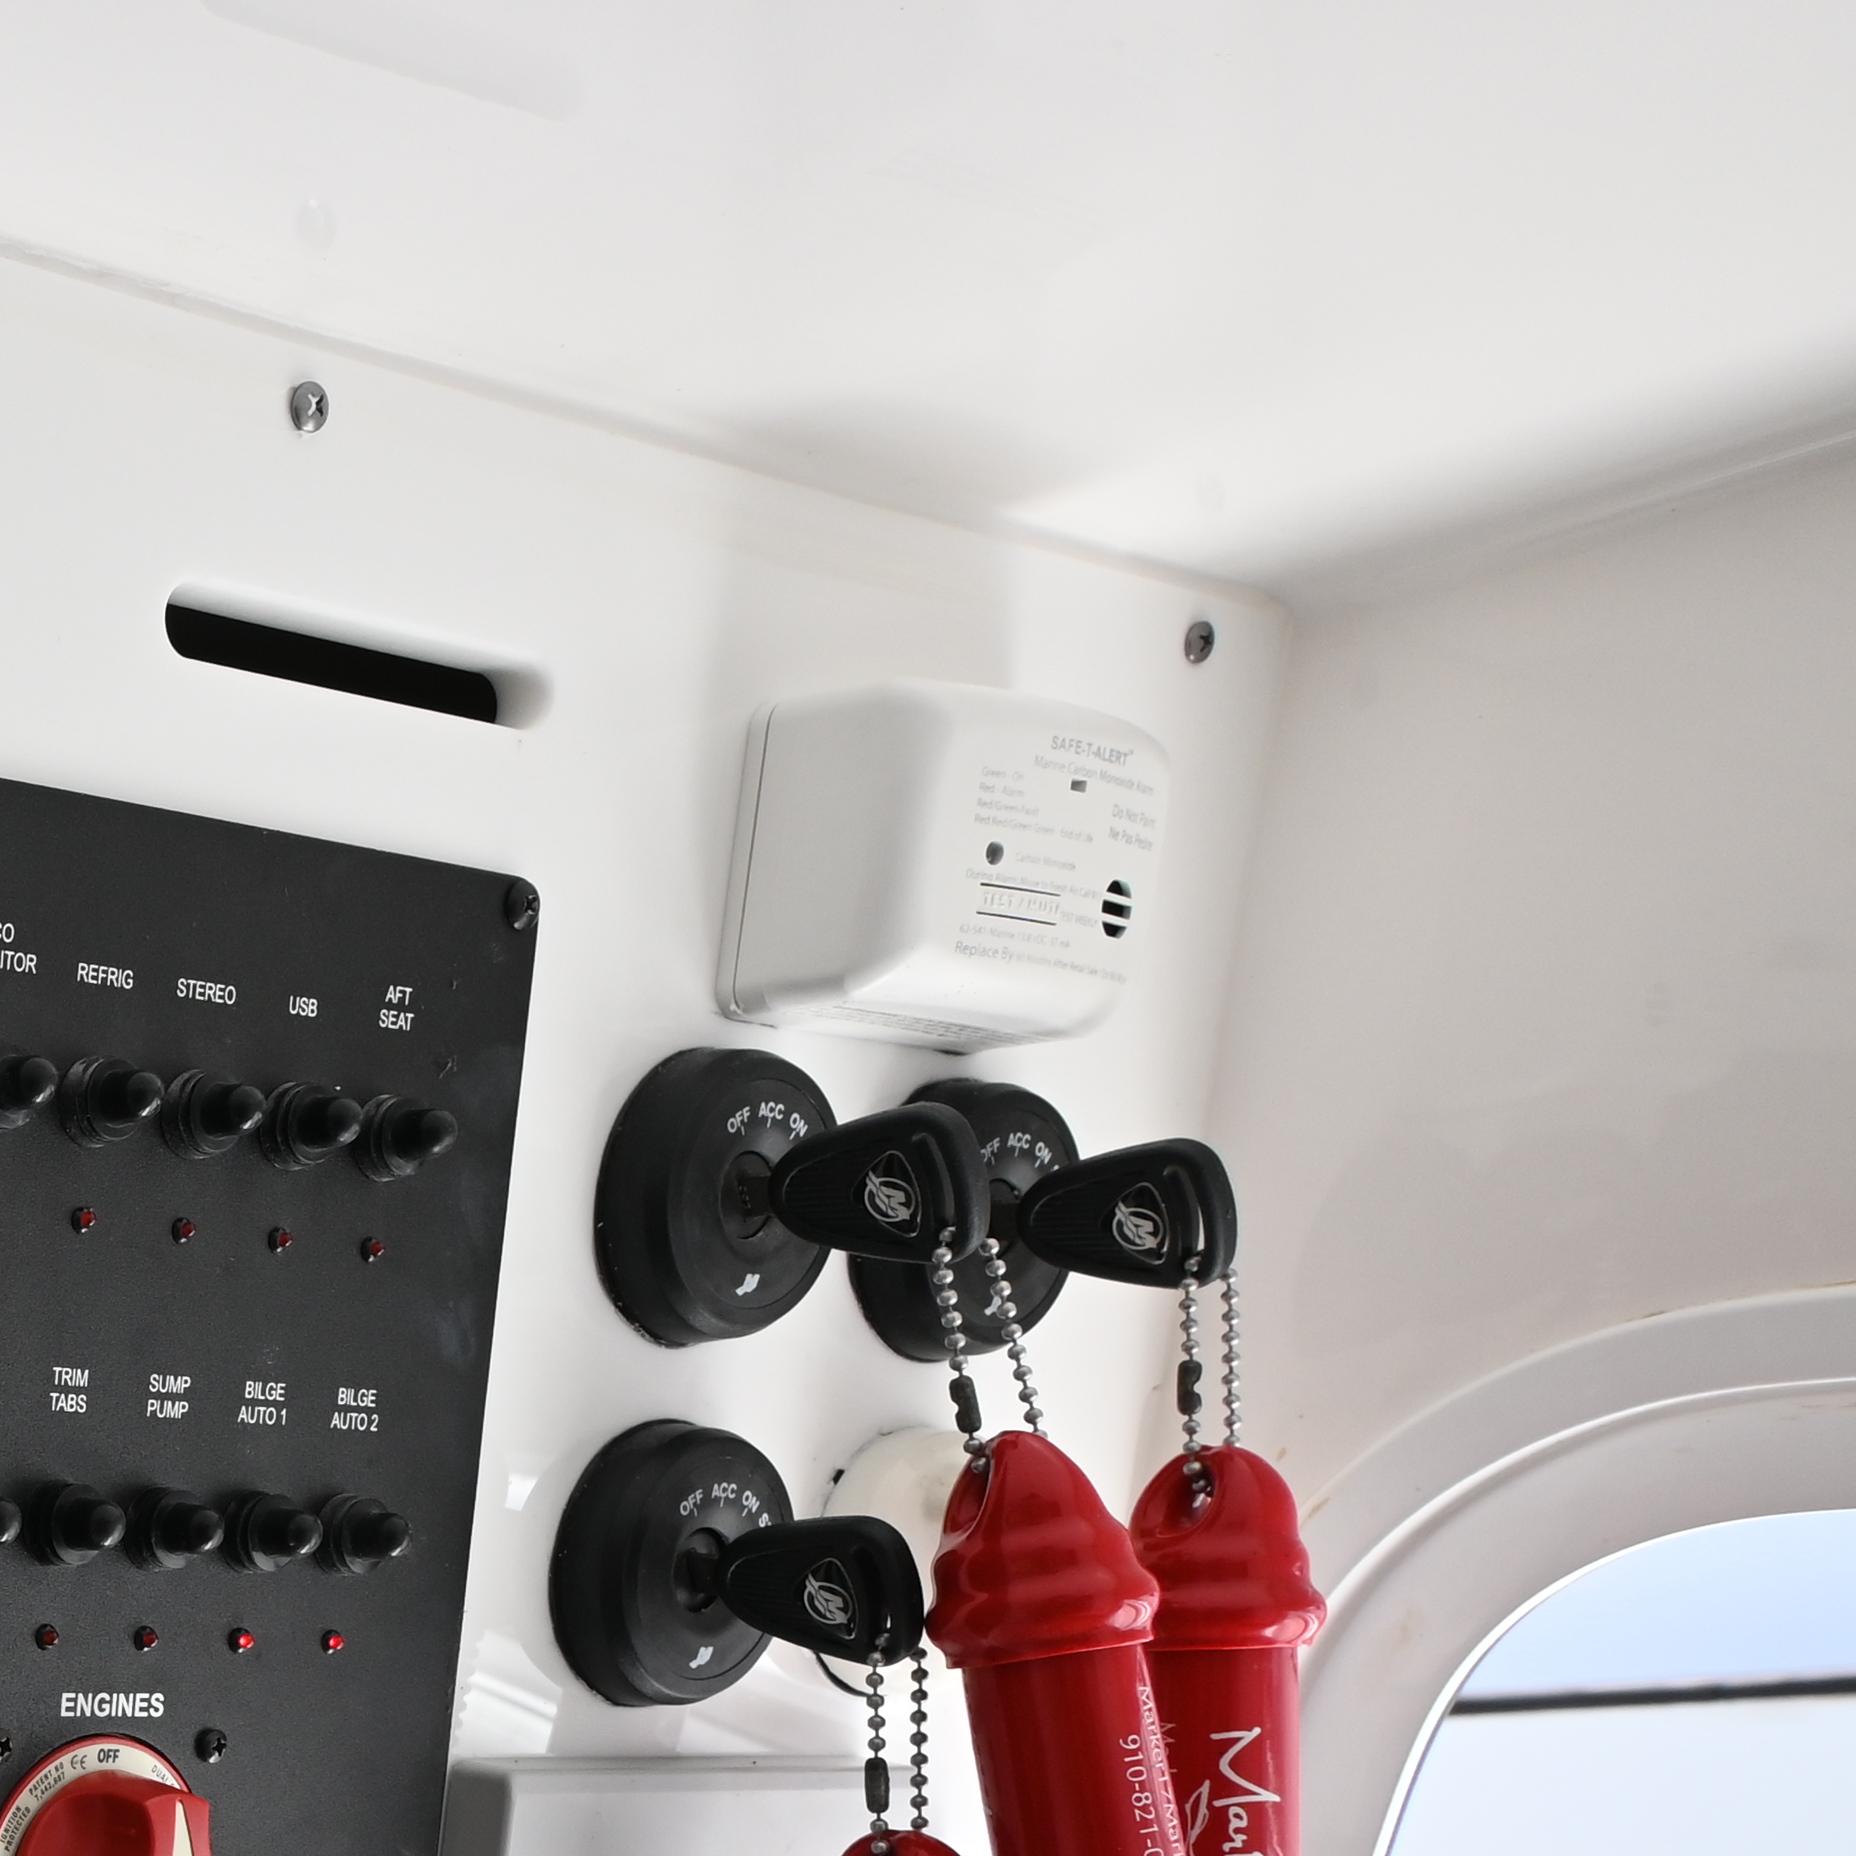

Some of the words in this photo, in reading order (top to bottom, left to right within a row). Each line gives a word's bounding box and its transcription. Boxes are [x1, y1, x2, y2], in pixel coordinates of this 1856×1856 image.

[77, 963, 133, 989] REFRIG
[177, 978, 236, 1004] STEREO
[385, 985, 413, 1005] AFT
[289, 995, 318, 1017] USB
[379, 1009, 414, 1031] SEAT
[727, 1106, 751, 1134] OFF
[758, 1101, 785, 1120] ACC
[789, 1113, 808, 1138] ON
[53, 1367, 89, 1387] TRIM
[149, 1374, 191, 1394] SUMP
[245, 1381, 286, 1401] BILGE
[338, 1387, 377, 1407] BILGE
[50, 1393, 86, 1413] TABS
[147, 1399, 189, 1419] PUMP
[238, 1405, 276, 1425] AUTO
[281, 1408, 286, 1425] 1
[330, 1412, 367, 1431] AUTO
[370, 1414, 379, 1431] 2
[680, 1489, 703, 1515] OFF
[712, 1482, 737, 1499] ACC
[743, 1490, 760, 1513] ON
[60, 1692, 165, 1718] ENGINES
[97, 1748, 120, 1764] OFF
